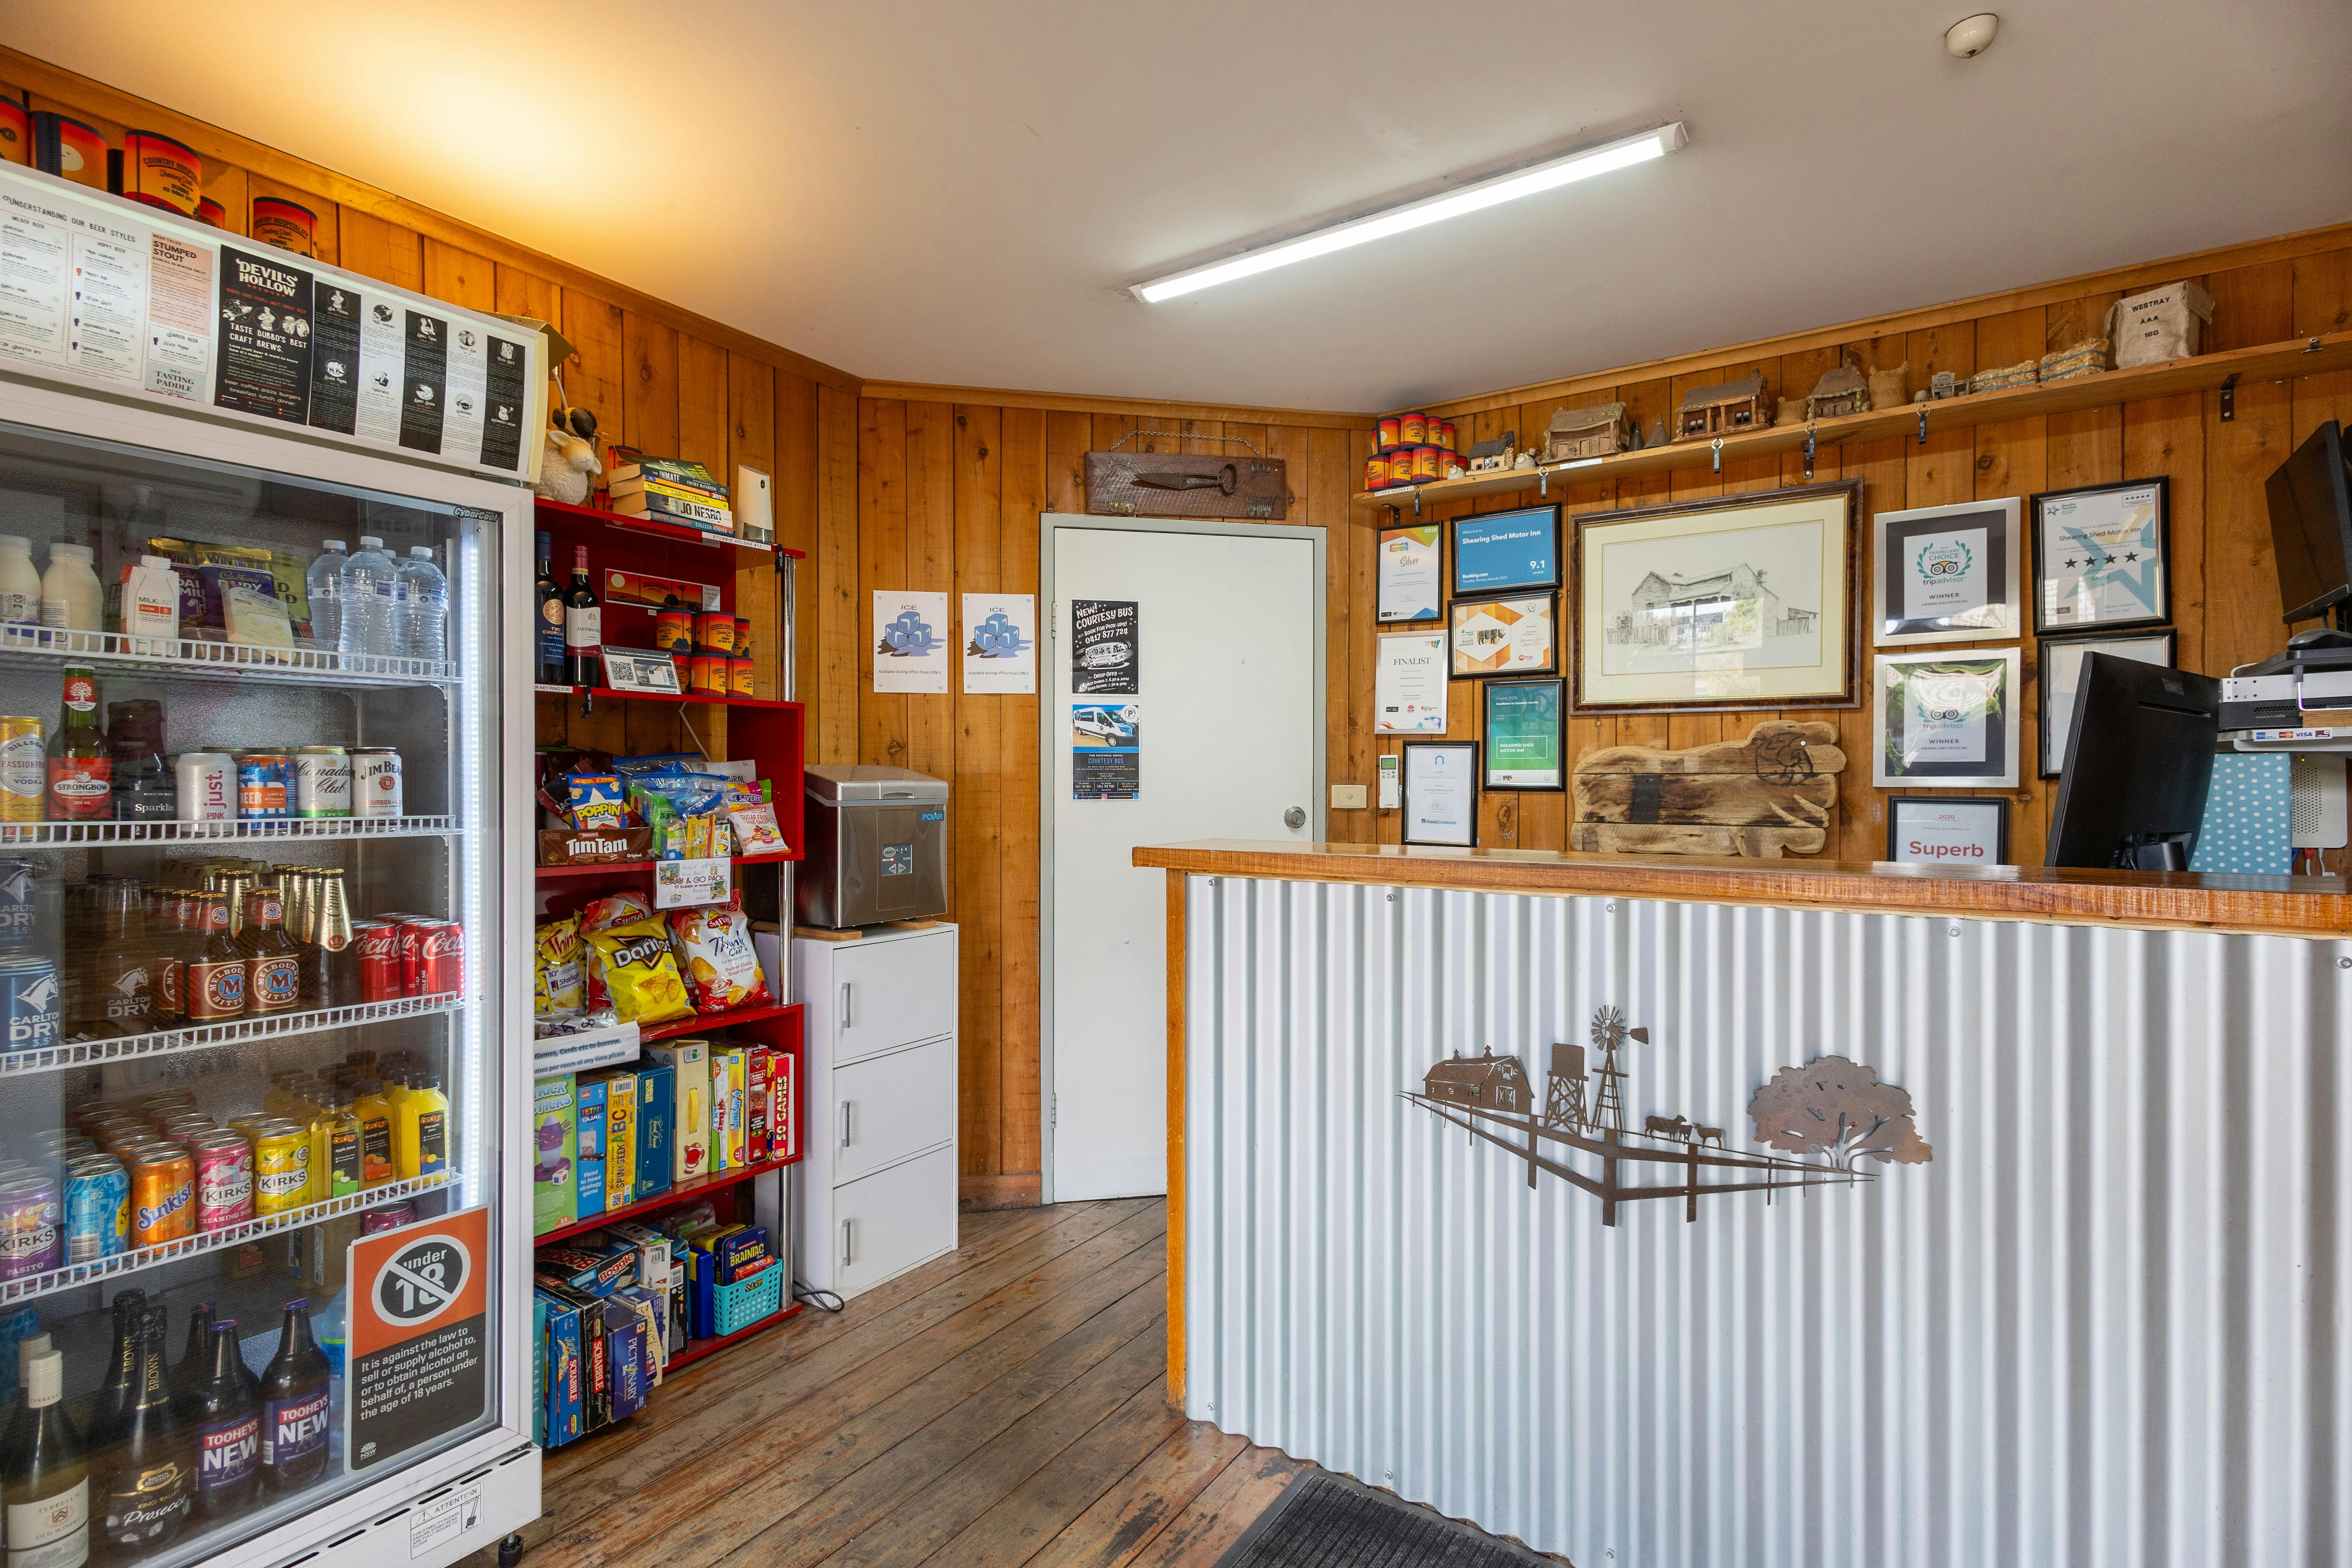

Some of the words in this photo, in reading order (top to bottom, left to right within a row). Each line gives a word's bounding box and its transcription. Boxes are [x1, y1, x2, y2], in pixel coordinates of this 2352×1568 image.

[72, 218, 85, 227] OUR
[90, 224, 106, 234] BEER
[111, 230, 135, 242] STYLES
[153, 249, 184, 262] STOUT
[154, 241, 196, 258] STUMPED
[236, 258, 298, 287] DEVIL'S
[239, 272, 296, 297] HOLLOW
[2132, 297, 2170, 312] WESTRAY
[2140, 316, 2158, 325] AAA
[230, 323, 253, 334] TASTE
[257, 330, 286, 343] DUBBO'S
[290, 339, 307, 349] BEST
[230, 333, 252, 345] CRAFT
[257, 340, 283, 352] BREWS.
[156, 371, 194, 385] TASTING
[157, 379, 192, 392] PADDLE
[659, 471, 680, 483] INMATE
[1462, 536, 1490, 545] Shearing
[1400, 556, 1419, 567] Silver
[1530, 560, 1545, 569] 9.1
[1923, 577, 1964, 586] tripadvisor
[1076, 603, 1097, 619] NEW!
[1076, 610, 1116, 630] COURTESY
[1118, 607, 1133, 617] BUS
[1085, 632, 1100, 644] 0417
[1102, 629, 1114, 638] 877
[203, 770, 227, 809] just.
[922, 812, 942, 820] POLAR
[1909, 841, 1984, 858] Superb
[544, 929, 579, 956] Thins
[615, 939, 671, 967] Doritos
[258, 963, 298, 985] MELBOURNE
[559, 973, 580, 985] Starlight
[262, 986, 297, 999] BITTER
[597, 1038, 621, 1047] borrow.
[609, 1051, 625, 1060] please
[534, 1082, 566, 1098] TRICK
[776, 1076, 787, 1122] GAMES
[776, 1125, 786, 1140] 50
[261, 1171, 305, 1189] KIRKS
[206, 1182, 250, 1202] KIRKS
[138, 1180, 193, 1230] Sunkist
[403, 1249, 447, 1270] under
[730, 1243, 764, 1267] BRAINIAC
[6, 1262, 44, 1276] PASITO
[599, 1253, 635, 1283] Boggle
[396, 1263, 446, 1312] 18
[361, 1372, 379, 1384] sell
[381, 1367, 392, 1376] or
[394, 1353, 426, 1372] supply
[429, 1339, 462, 1359] alcohol
[464, 1336, 476, 1345] to,
[362, 1363, 369, 1372] It
[372, 1359, 379, 1368] is
[383, 1345, 419, 1365] against
[420, 1338, 437, 1350] the
[439, 1332, 457, 1344] law
[458, 1328, 468, 1337] to
[148, 1353, 159, 1392] BROWN
[361, 1387, 372, 1396] or
[374, 1382, 384, 1391] to
[387, 1369, 417, 1386] obtain
[420, 1354, 454, 1374] alcohol
[457, 1349, 468, 1359] on
[594, 1341, 603, 1391] SCRABBLE
[628, 1337, 637, 1399] PICTIONARY
[361, 1388, 392, 1408] behalf
[395, 1384, 407, 1395] of,
[417, 1368, 450, 1388] person
[452, 1357, 478, 1373] under
[282, 1395, 328, 1421] TOOHEYS
[360, 1408, 377, 1420] the
[380, 1399, 398, 1416] age
[401, 1394, 411, 1404] of
[414, 1389, 423, 1399] 18
[426, 1378, 454, 1396] years.
[207, 1419, 257, 1446] TOOHEYS
[278, 1406, 328, 1445] NEW
[204, 1431, 258, 1471] NEW
[124, 1494, 187, 1526] Prosecco
